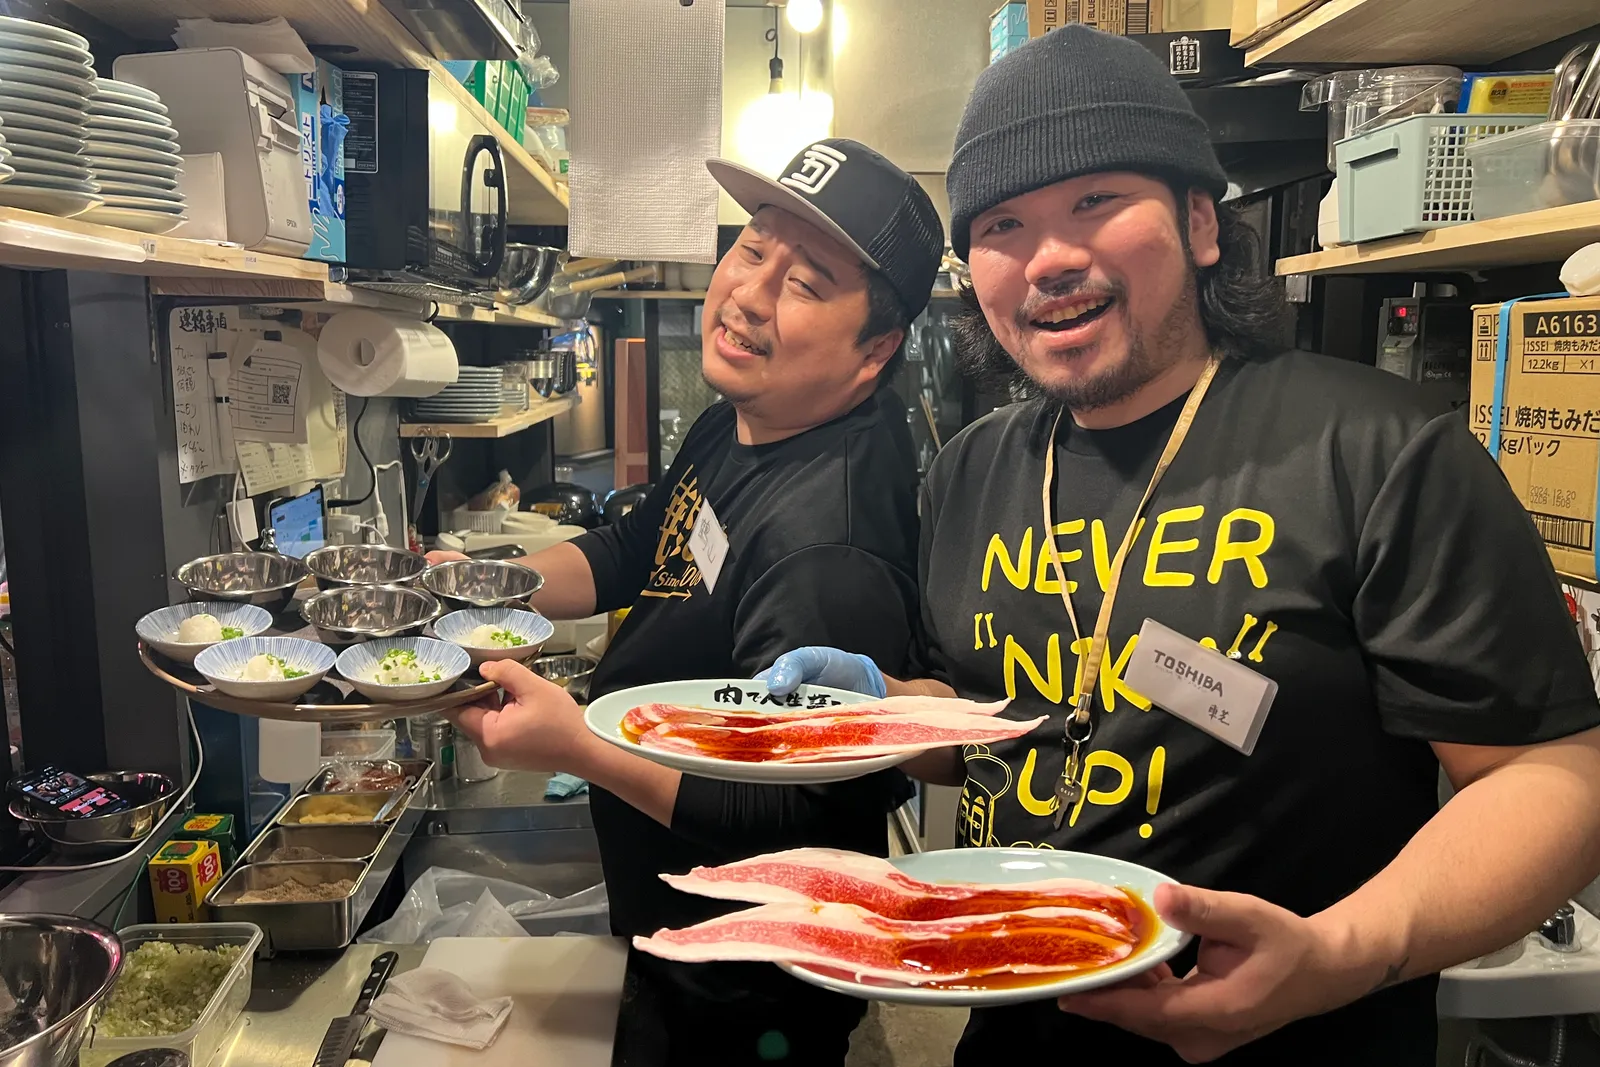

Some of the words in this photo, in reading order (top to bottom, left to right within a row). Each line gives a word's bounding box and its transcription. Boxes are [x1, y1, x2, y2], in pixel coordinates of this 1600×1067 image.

[179, 309, 227, 333] 連絡事項
[1535, 314, 1597, 335] A6163
[1526, 341, 1549, 352] ISSEI
[1554, 340, 1600, 352] 焼肉もみだ
[1528, 359, 1559, 371] 12.2kg
[982, 505, 1275, 594] NEVER
[1154, 649, 1224, 698] TOSHIBA
[1017, 746, 1166, 839] UP!
[203, 854, 215, 882] 100
[167, 869, 182, 892] 100
